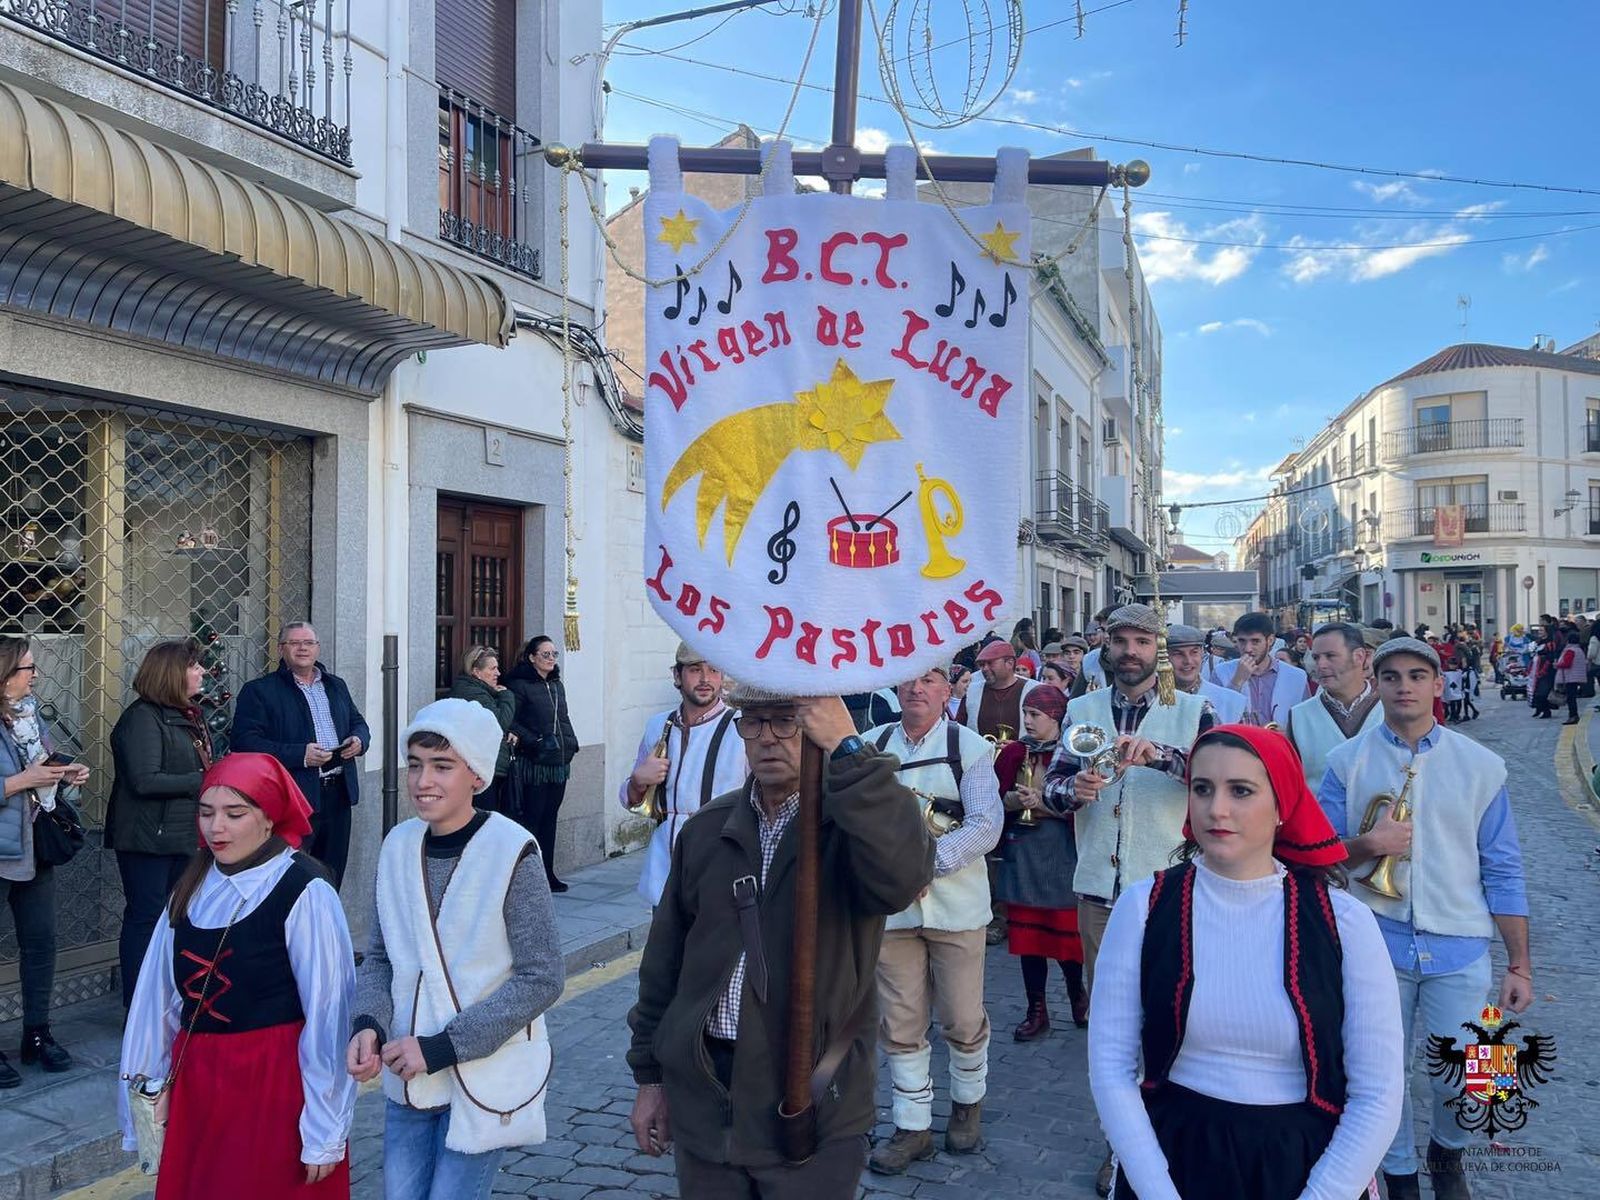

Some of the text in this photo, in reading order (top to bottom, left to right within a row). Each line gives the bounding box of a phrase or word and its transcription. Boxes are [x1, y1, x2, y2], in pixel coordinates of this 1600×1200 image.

[761, 228, 909, 289] B.C.T.
[649, 305, 1013, 418] Virgen de Luna
[492, 438, 501, 456] 2
[646, 545, 1003, 670] Los Pastores
